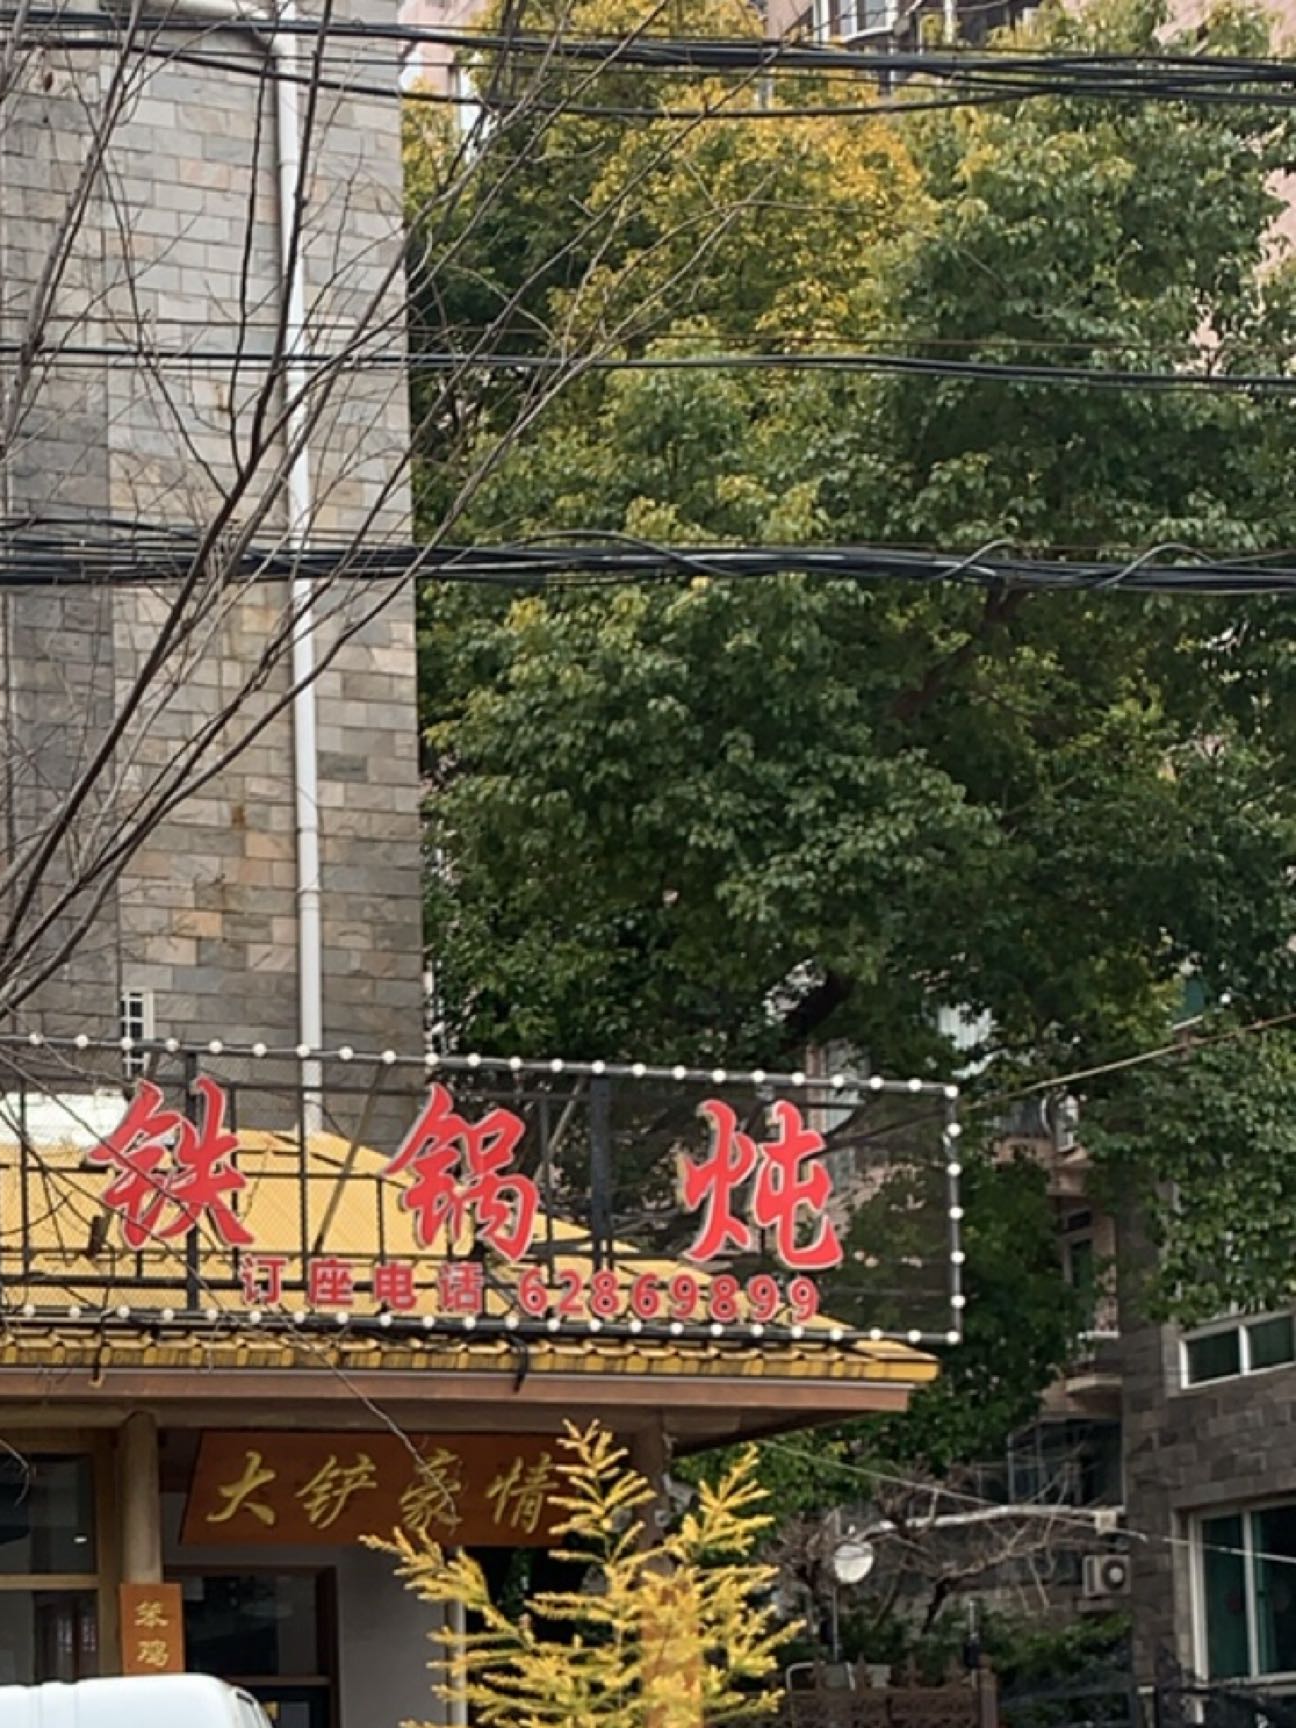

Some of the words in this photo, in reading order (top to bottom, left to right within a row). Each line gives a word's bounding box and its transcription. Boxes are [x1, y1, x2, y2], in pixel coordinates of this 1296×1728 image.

[238, 1252, 484, 1313] 订座电话
[518, 1267, 819, 1323] 62869899
